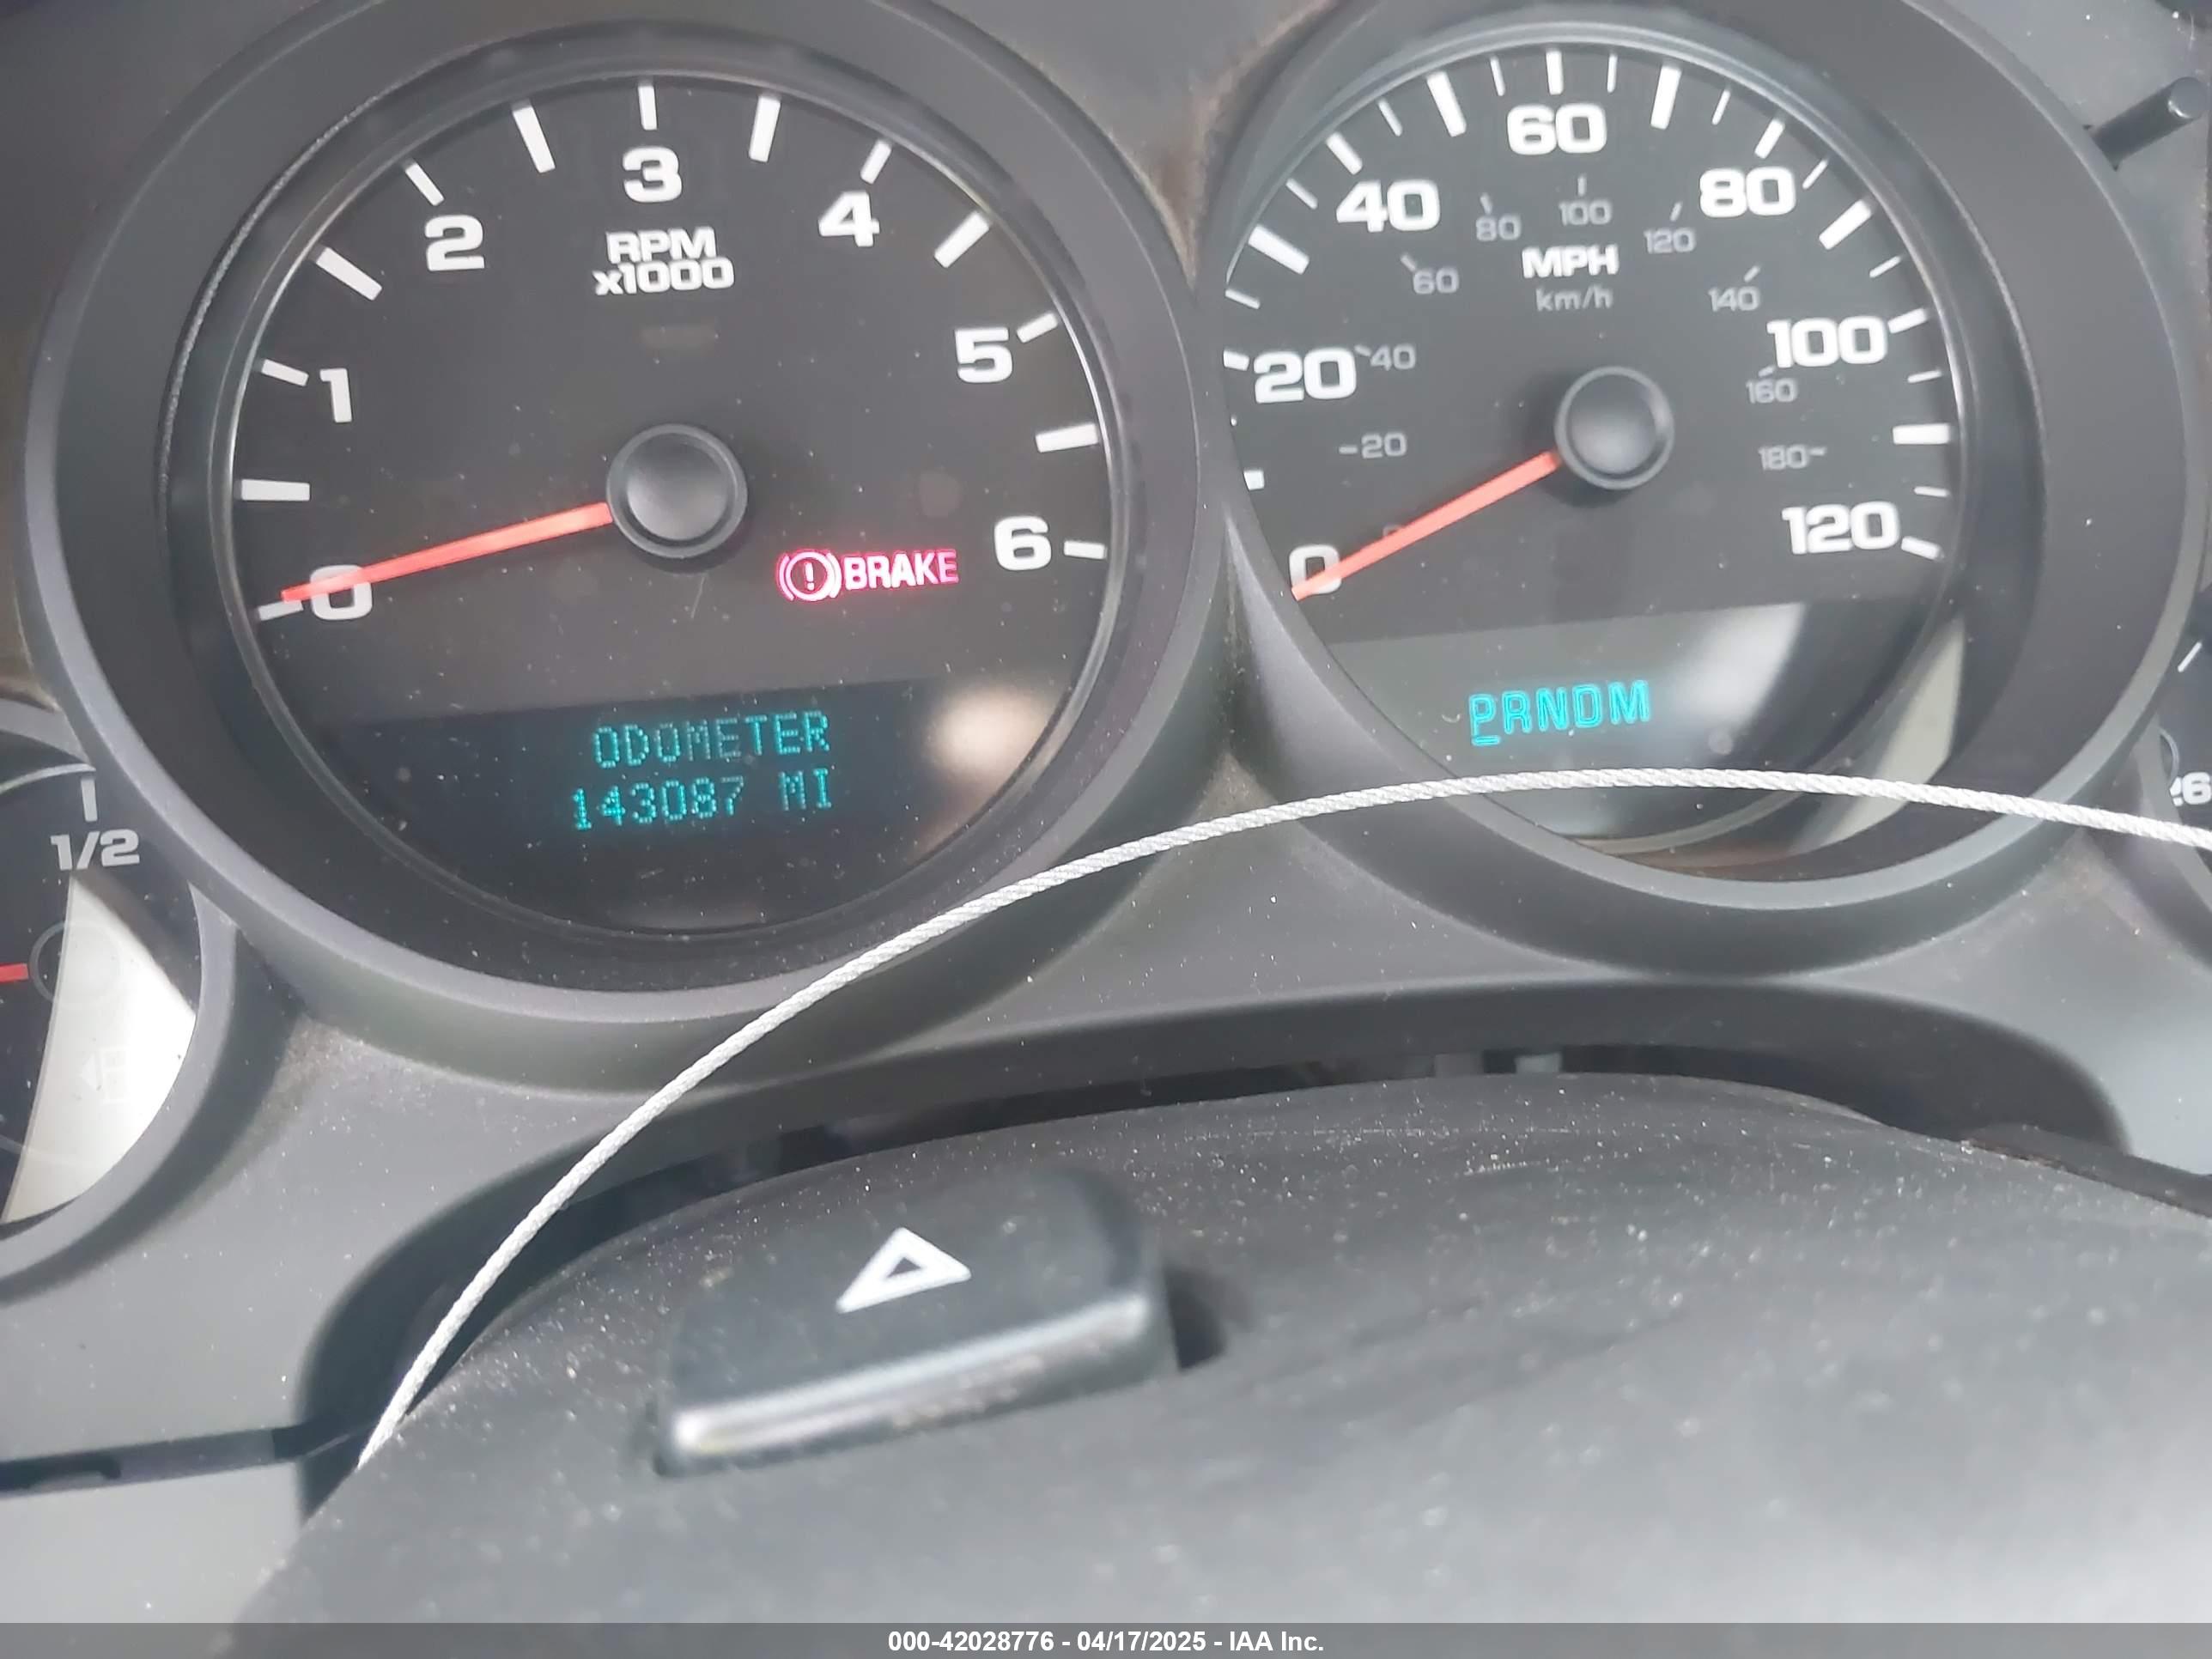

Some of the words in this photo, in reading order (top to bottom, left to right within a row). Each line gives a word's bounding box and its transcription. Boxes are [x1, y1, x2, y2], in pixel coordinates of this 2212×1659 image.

[1507, 103, 1607, 155] 60
[622, 146, 682, 203] 3
[1699, 166, 1796, 217] 80
[818, 191, 879, 246] 4
[1336, 179, 1440, 233] 40
[1476, 215, 1521, 242] 80
[1559, 200, 1612, 226] 100
[424, 215, 484, 271] 2
[605, 227, 717, 264] RPM
[1521, 244, 1619, 278] MPH
[1644, 228, 1696, 253] 120
[592, 257, 734, 295] x1000
[1413, 268, 1459, 295] 60
[1536, 283, 1613, 311] km/h
[1708, 287, 1760, 311] 140
[955, 327, 1012, 382] 5
[1370, 344, 1415, 371] 40
[1766, 316, 1887, 368] 100
[319, 368, 352, 422] 1
[1254, 348, 1357, 403] 20
[1746, 377, 1798, 404] 160
[1361, 433, 1407, 459] 20
[1759, 445, 1808, 471] 180
[994, 516, 1051, 570] 6
[1781, 501, 1900, 555] 120
[310, 564, 373, 620] 0
[844, 549, 958, 591] BRAKE
[1289, 544, 1342, 595] 0
[1468, 679, 1650, 744] PRNDM
[592, 710, 831, 768] ODOMETER
[570, 775, 744, 831] 143087
[779, 768, 832, 811] MI
[50, 829, 140, 871] 1/2
